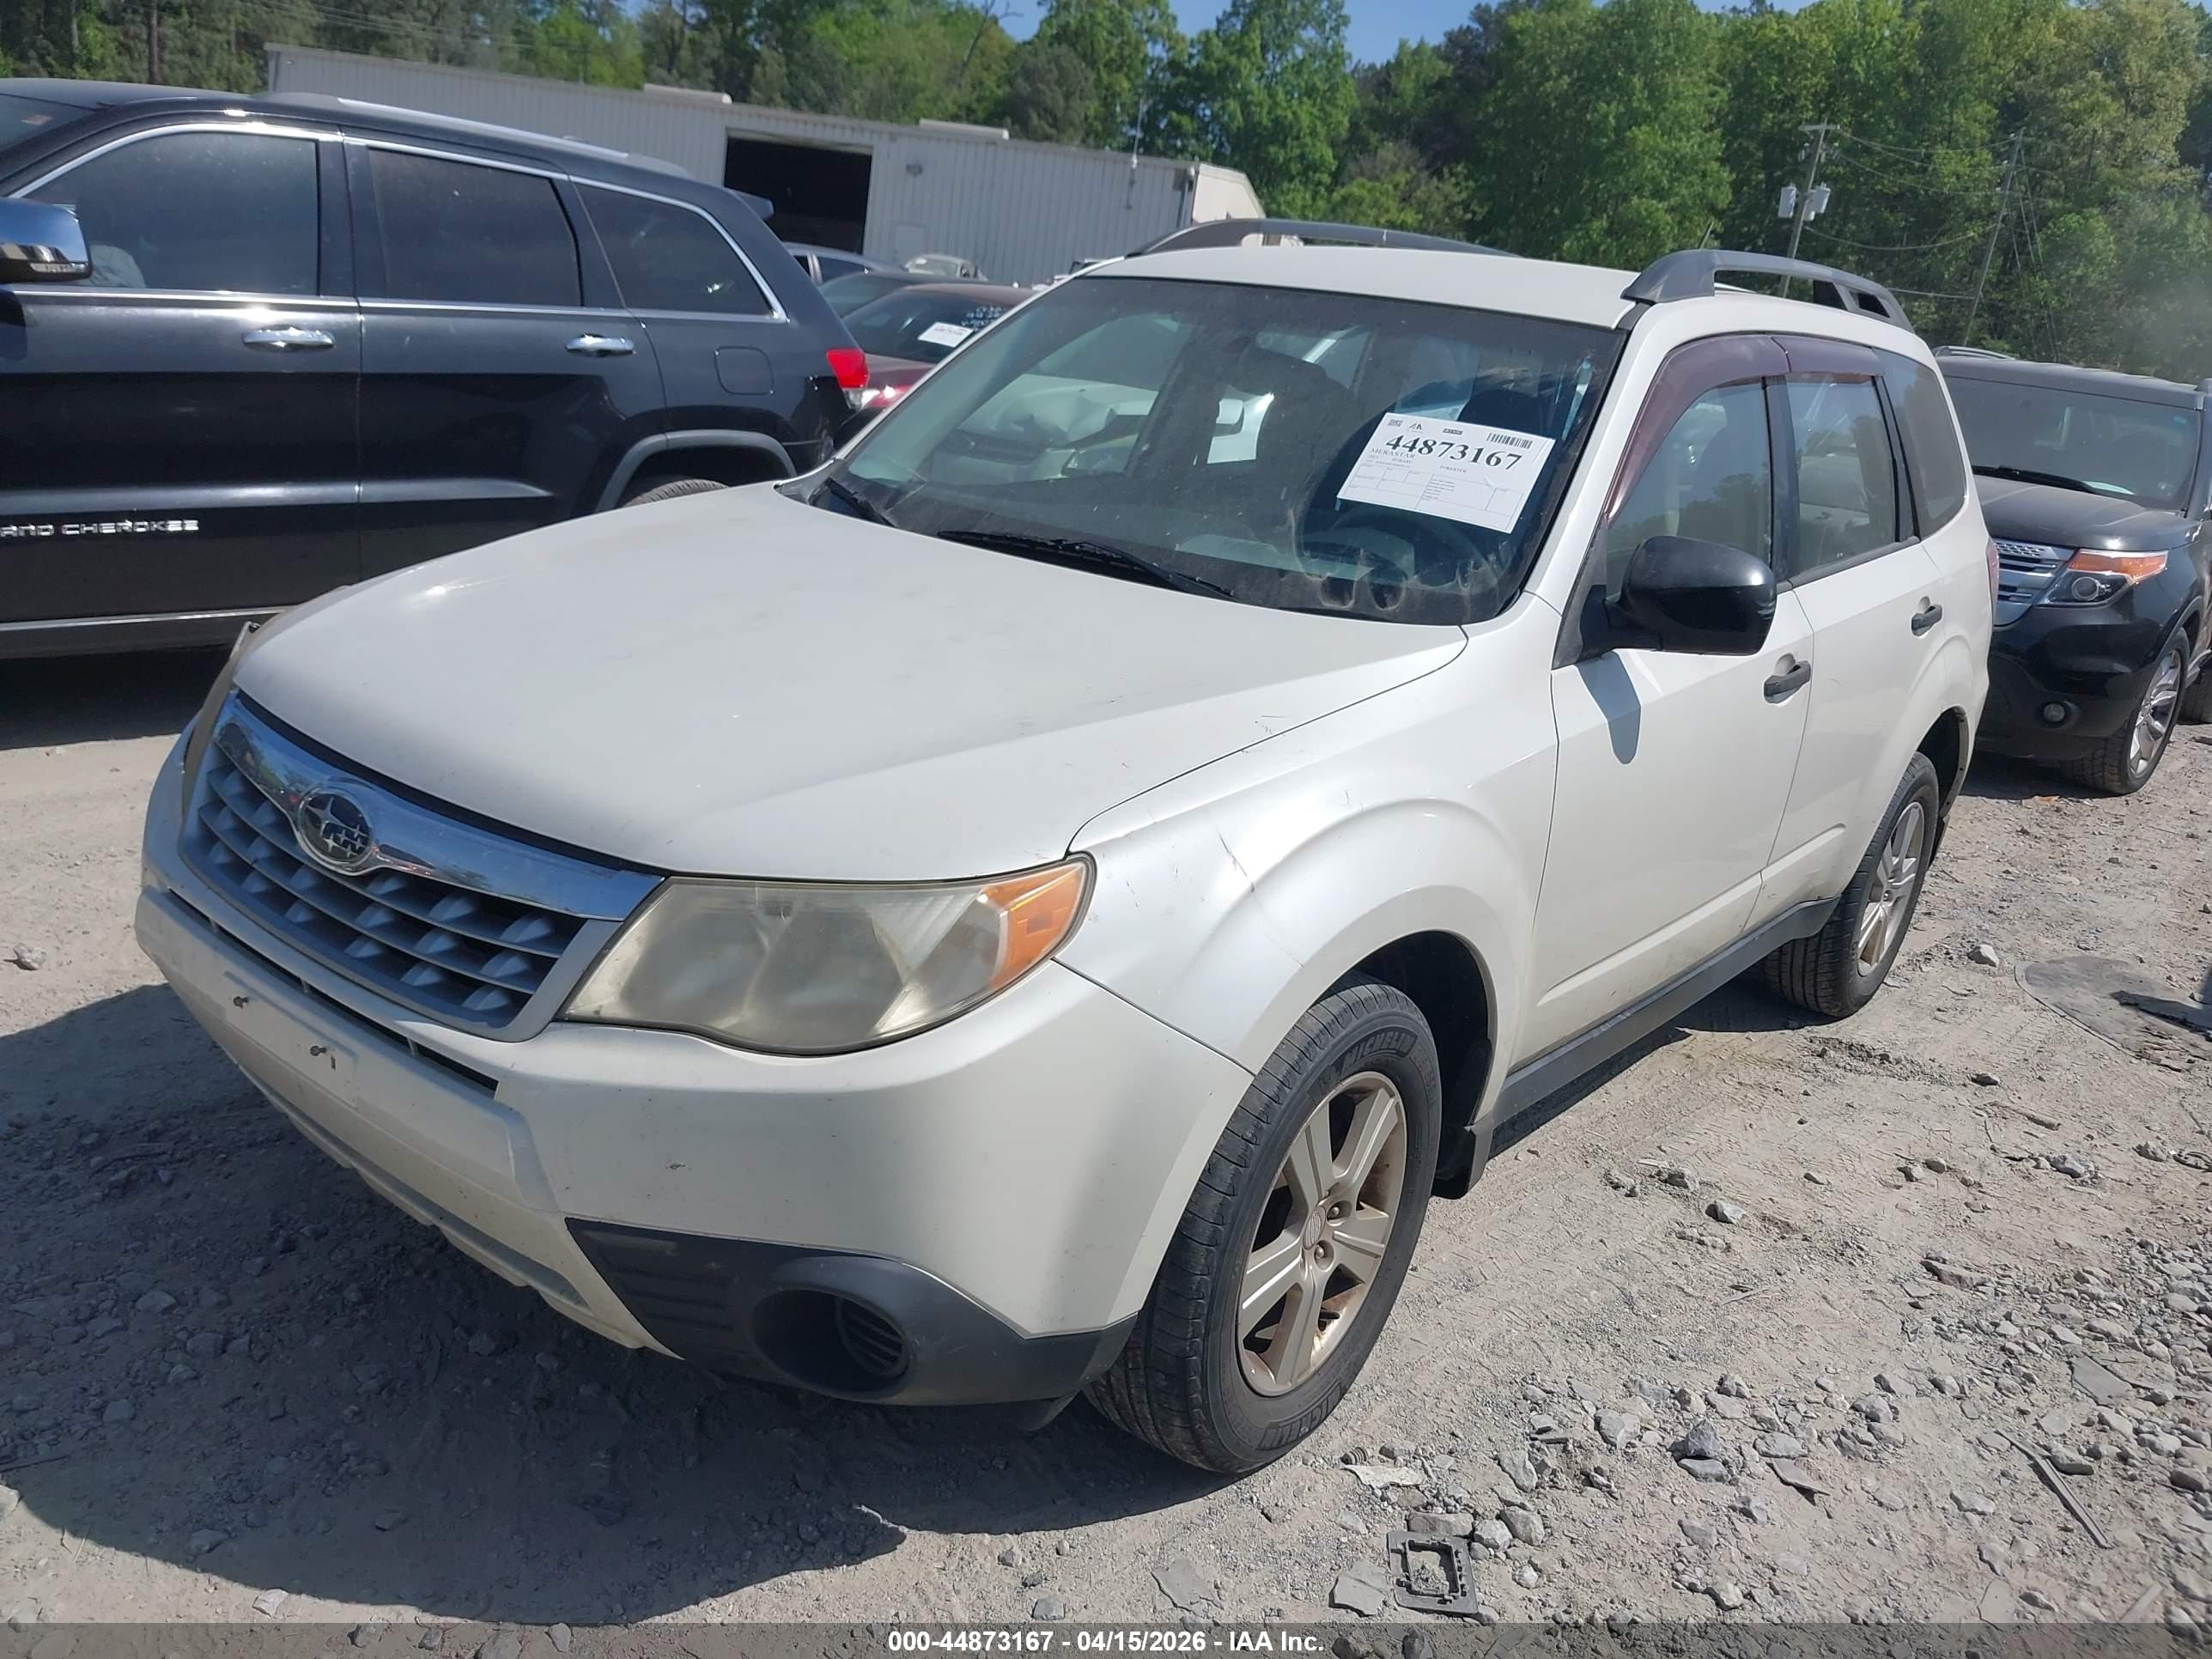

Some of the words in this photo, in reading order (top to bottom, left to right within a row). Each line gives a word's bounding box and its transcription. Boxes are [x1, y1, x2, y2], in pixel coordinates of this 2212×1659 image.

[1370, 447, 1416, 459] MERASTAR
[1385, 434, 1524, 471] 44873167
[61, 519, 199, 535] CHEROKEE
[1344, 1031, 1416, 1071] MICHELIN
